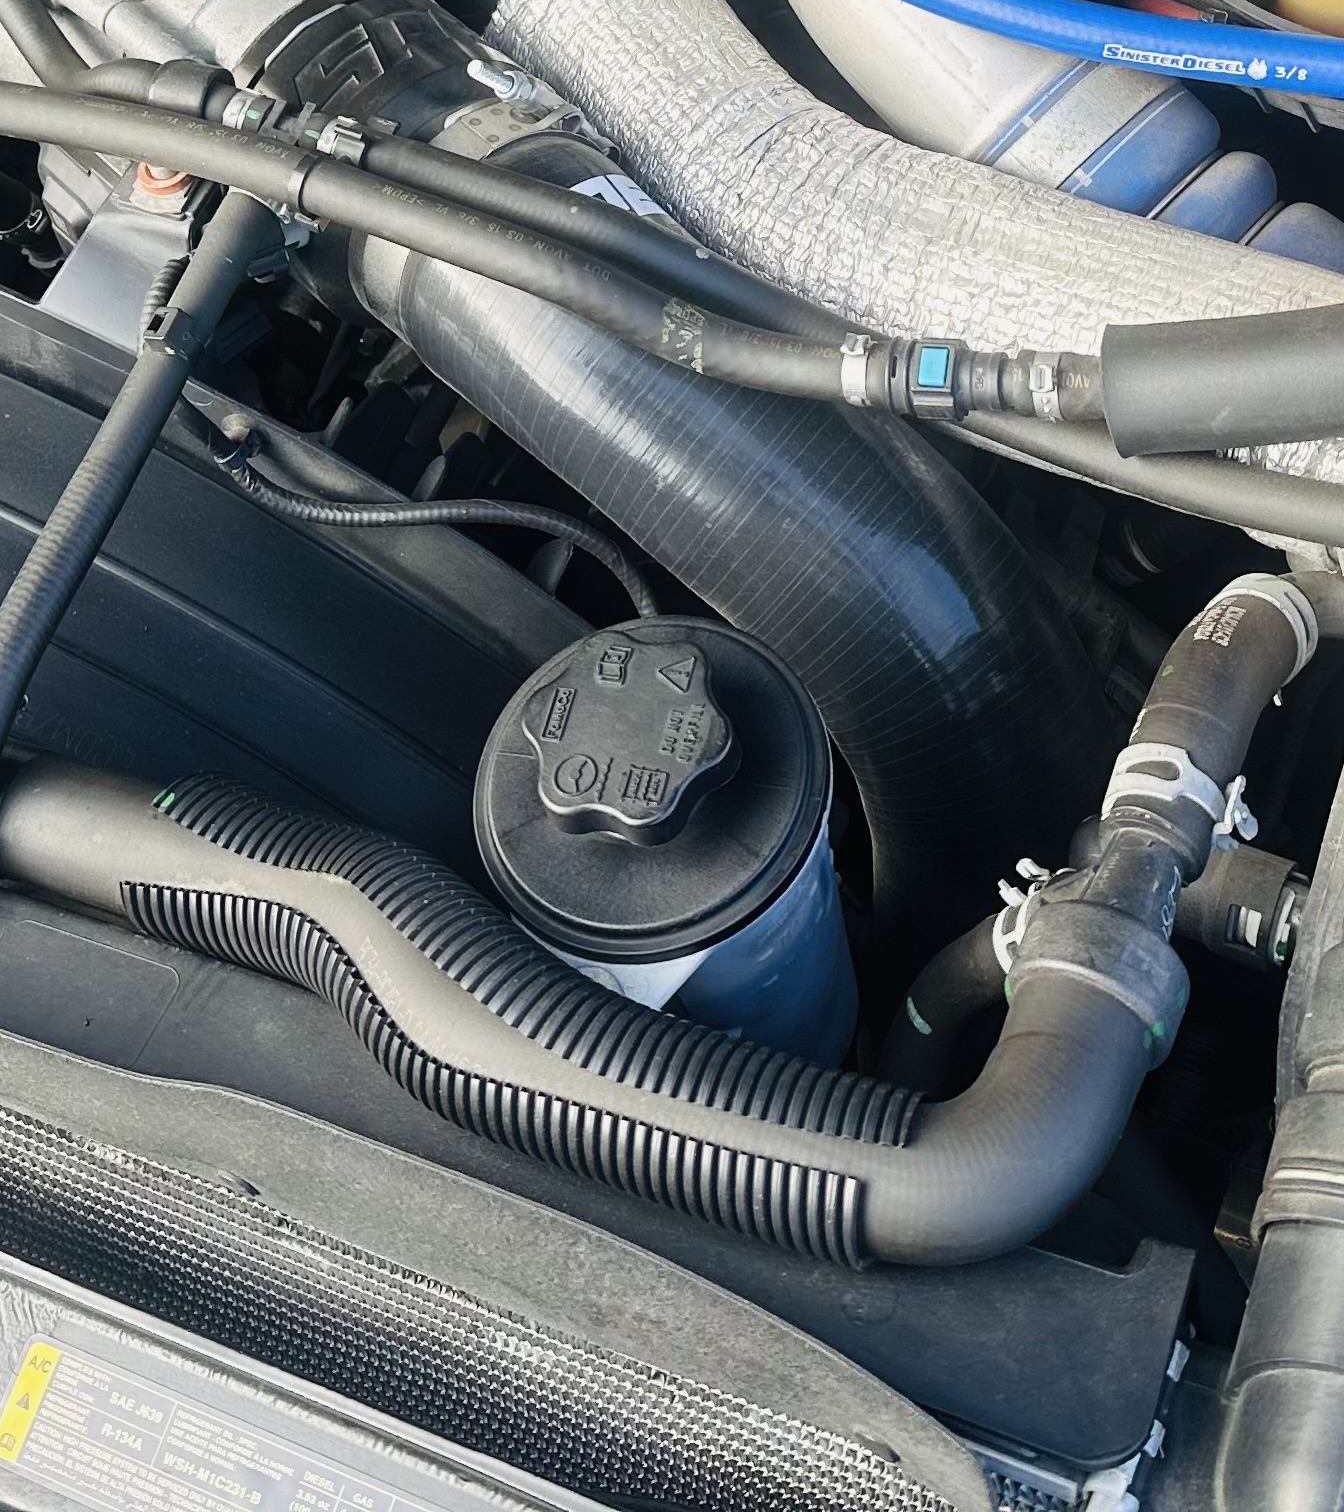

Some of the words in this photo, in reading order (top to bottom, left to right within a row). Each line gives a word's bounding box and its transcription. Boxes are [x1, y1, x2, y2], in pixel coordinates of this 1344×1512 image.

[1274, 65, 1307, 80] 3/8
[255, 140, 292, 159] AVON
[432, 203, 449, 216] VL
[457, 211, 478, 226] 3/8
[487, 221, 501, 234] 15
[506, 229, 525, 243] 03
[534, 239, 573, 262] AVON
[28, 1355, 52, 1374] A/C
[108, 1391, 136, 1412] SAE
[134, 1402, 164, 1424] J639
[100, 1422, 145, 1451] R-134A
[161, 1450, 263, 1506] WSH-M1C231-B
[304, 1472, 336, 1491] DIESEL
[295, 1489, 316, 1508] 3.53
[352, 1492, 374, 1509] GAS
